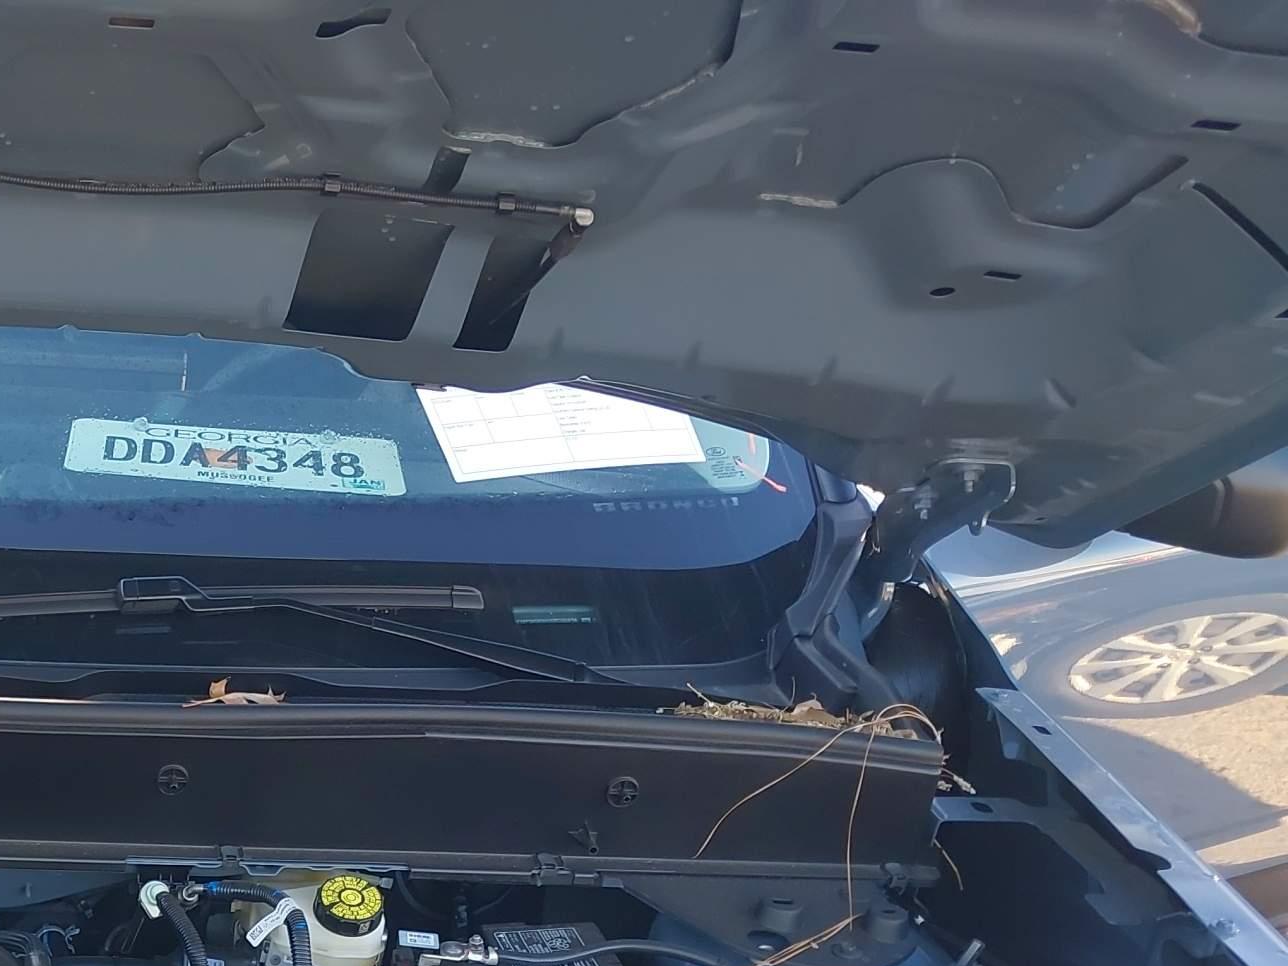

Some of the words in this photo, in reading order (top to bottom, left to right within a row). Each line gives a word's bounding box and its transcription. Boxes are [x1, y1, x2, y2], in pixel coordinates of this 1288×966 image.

[145, 427, 316, 447] GEORGIA
[103, 435, 365, 479] DDA4348
[349, 478, 381, 486] JAN
